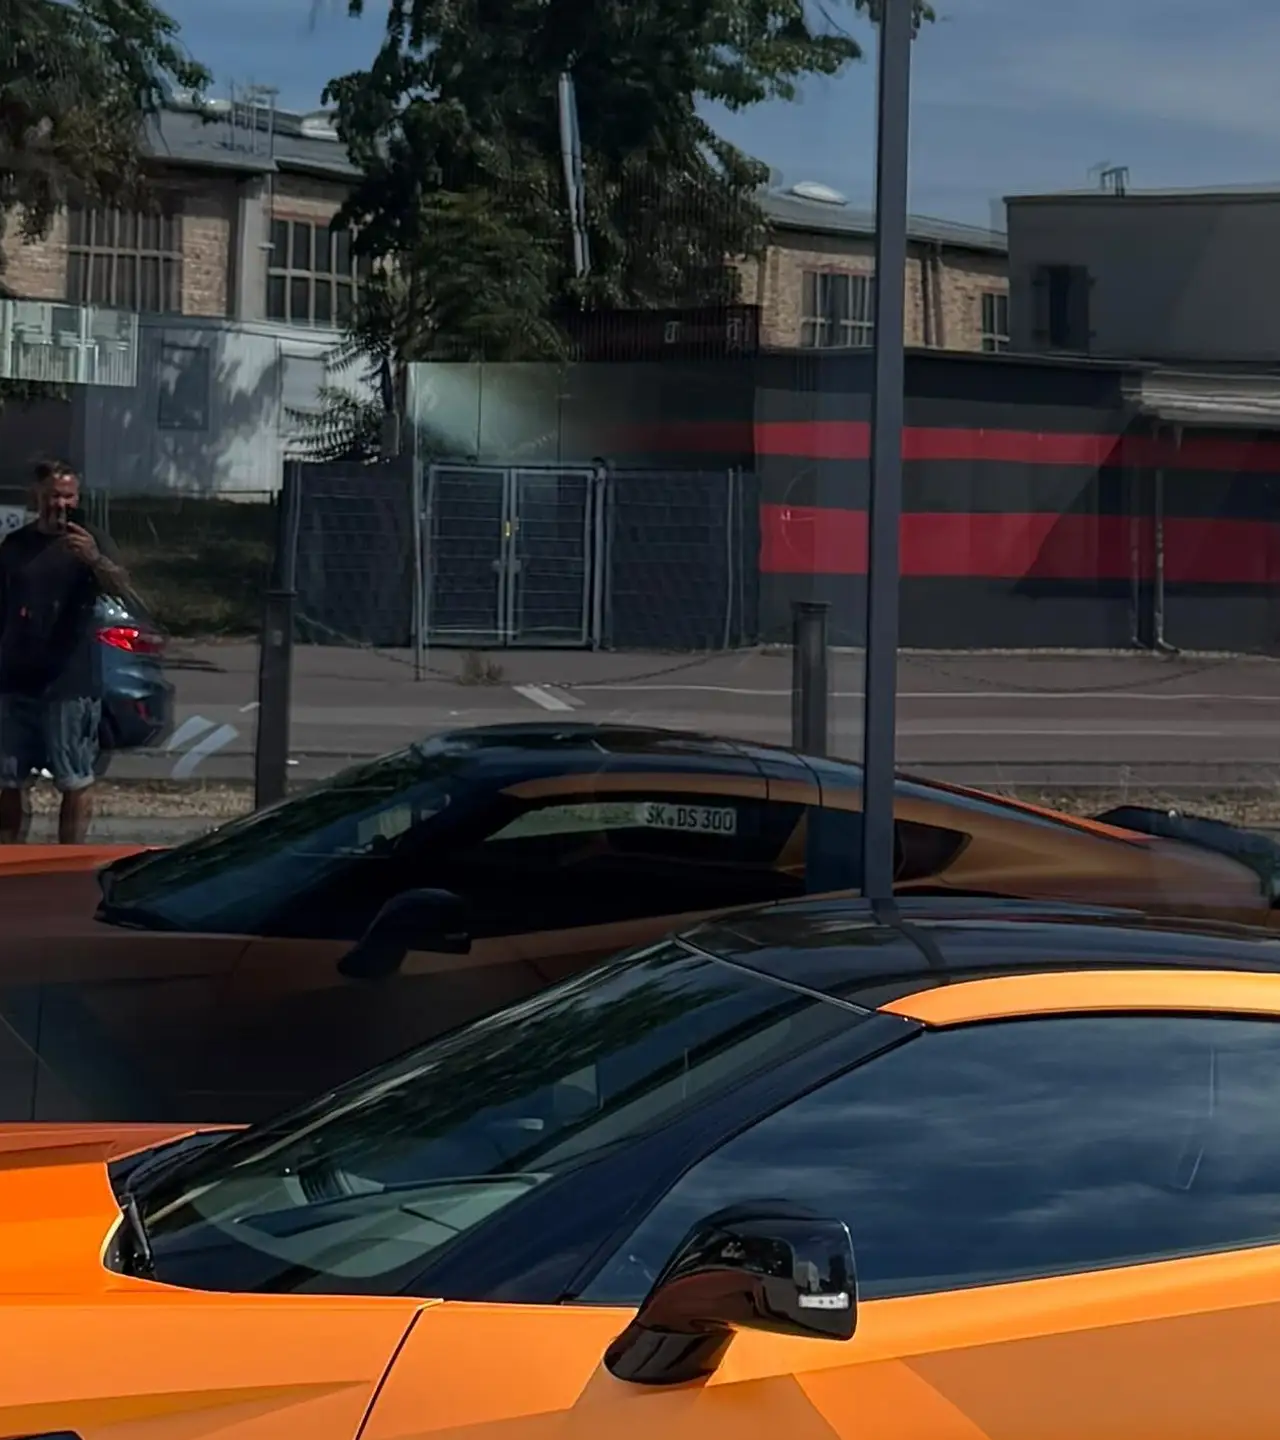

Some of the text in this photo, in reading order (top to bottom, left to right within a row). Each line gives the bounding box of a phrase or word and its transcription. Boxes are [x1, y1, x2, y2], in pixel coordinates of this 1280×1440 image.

[645, 804, 734, 831] SK DS 300
